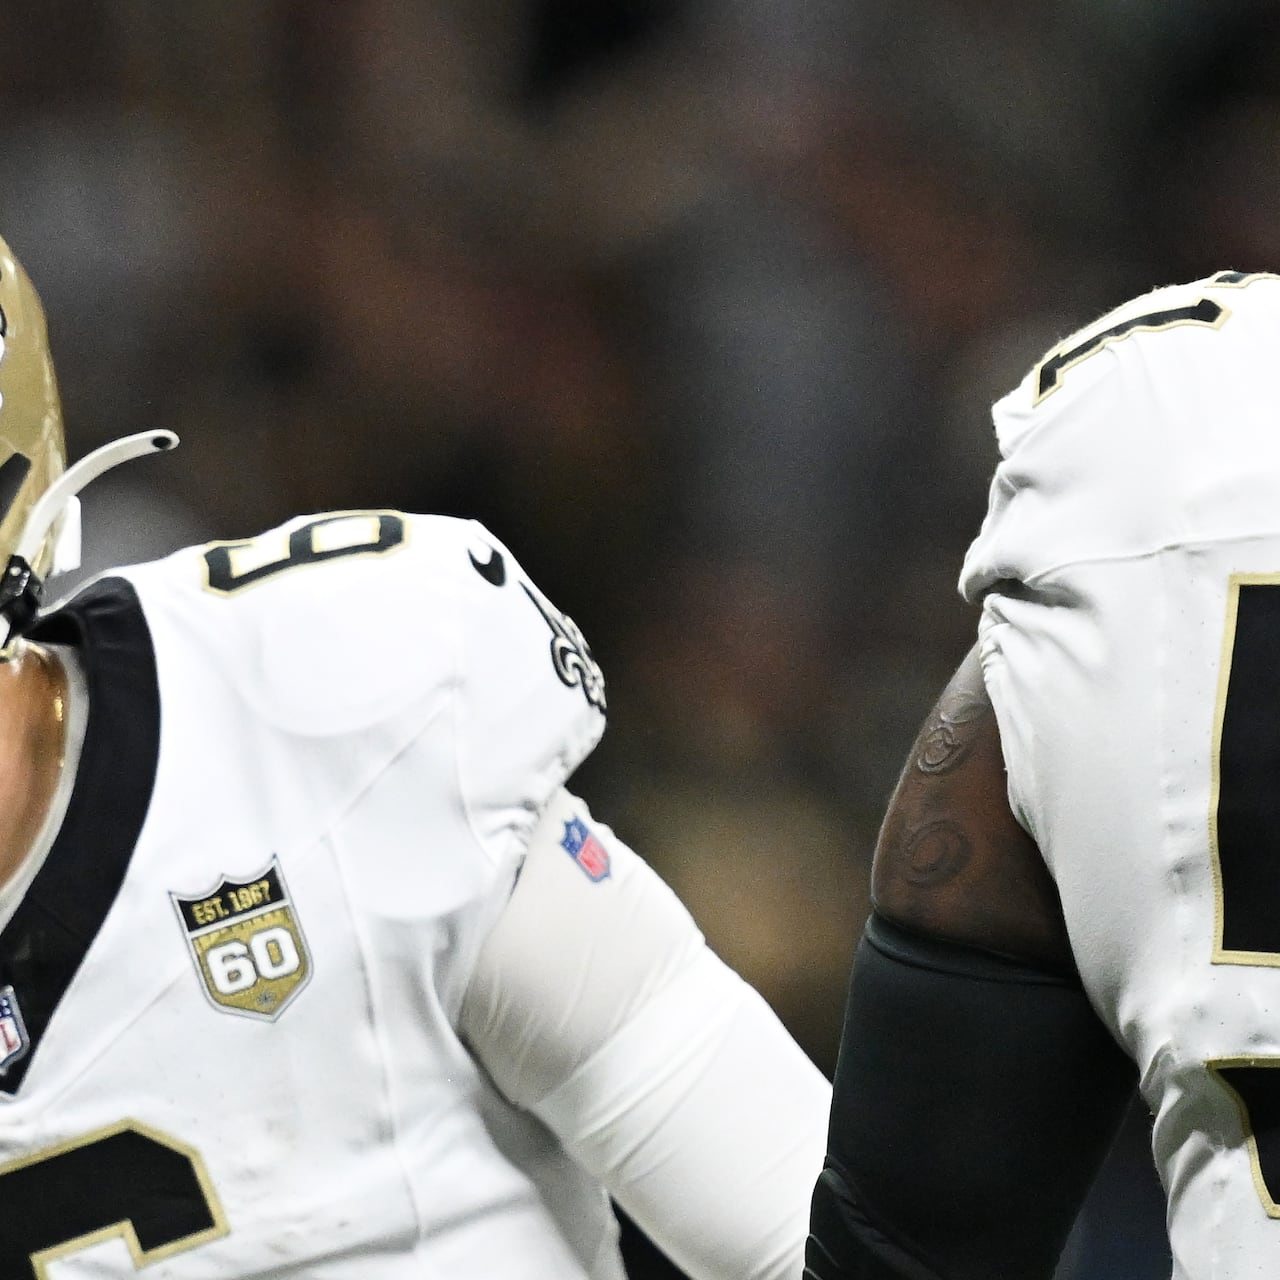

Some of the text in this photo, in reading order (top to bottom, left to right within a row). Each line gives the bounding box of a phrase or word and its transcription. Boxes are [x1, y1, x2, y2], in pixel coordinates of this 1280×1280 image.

[191, 879, 271, 925] EST. 1967
[206, 926, 300, 994] 60
